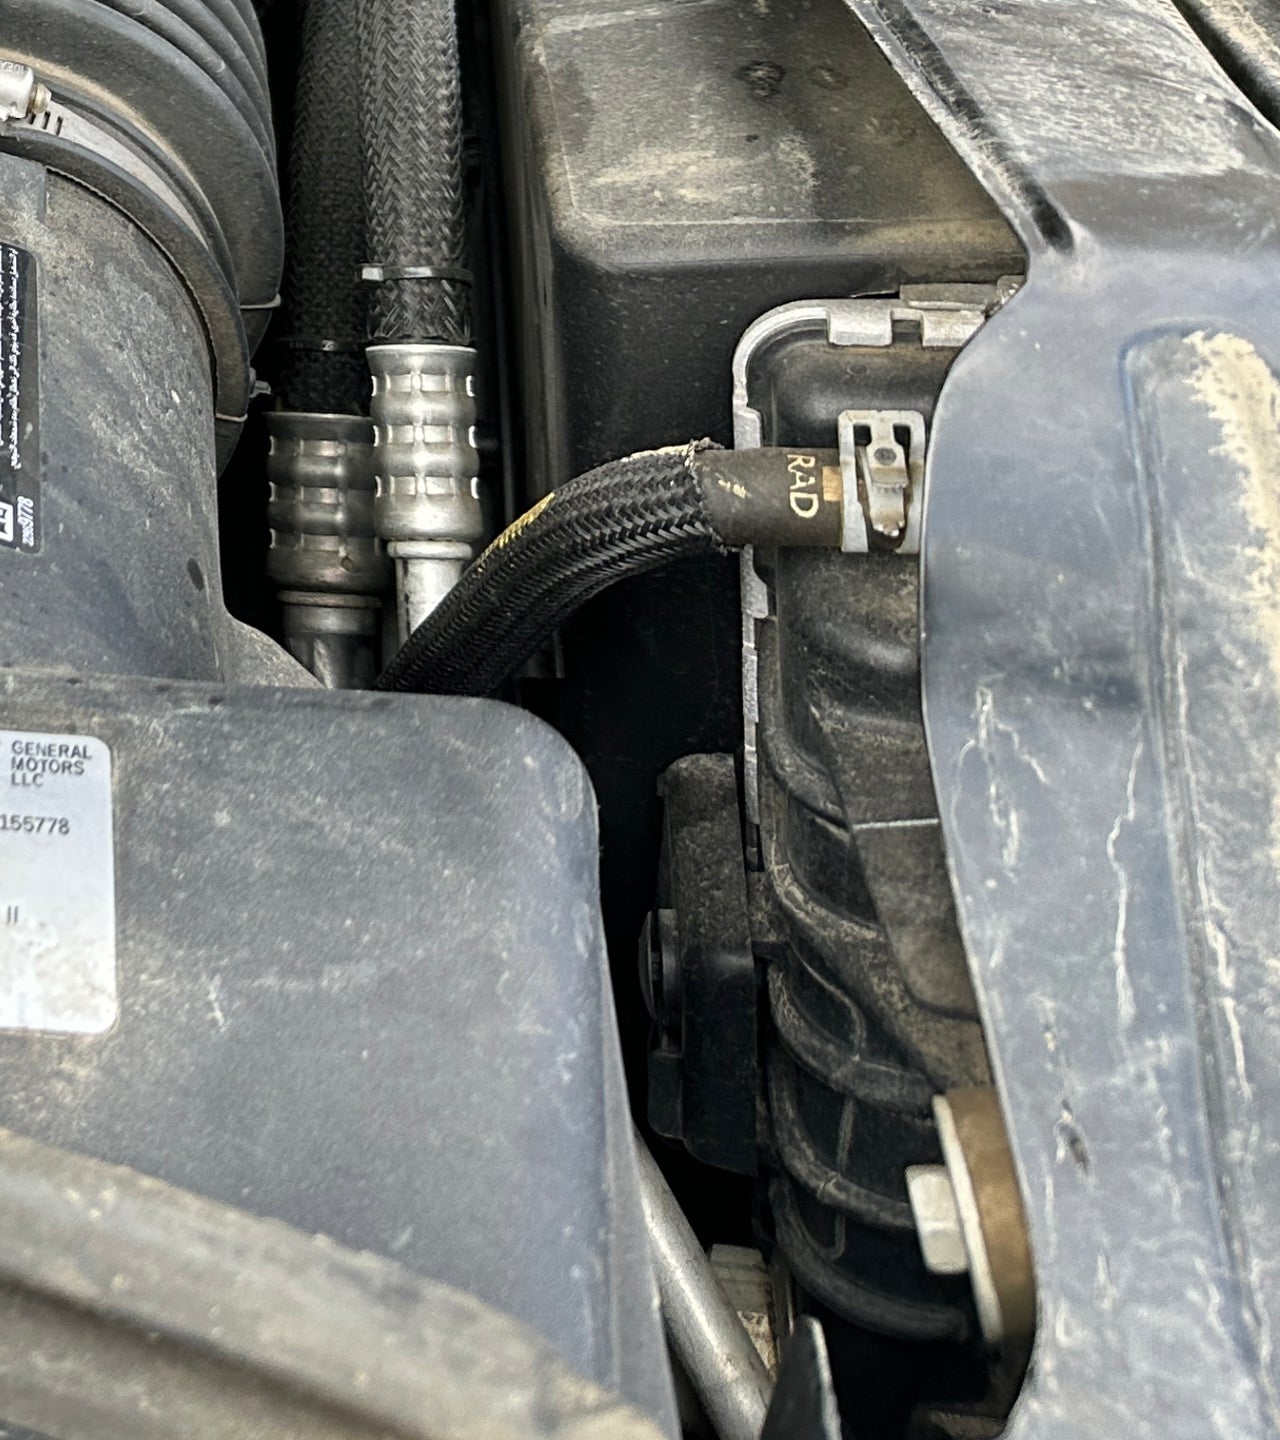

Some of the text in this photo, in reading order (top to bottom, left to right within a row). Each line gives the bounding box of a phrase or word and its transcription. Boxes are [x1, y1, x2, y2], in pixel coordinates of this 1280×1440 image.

[787, 454, 819, 518] RAD
[11, 740, 92, 760] GENERAL
[11, 757, 85, 776] MOTORS
[11, 772, 44, 787] LLC
